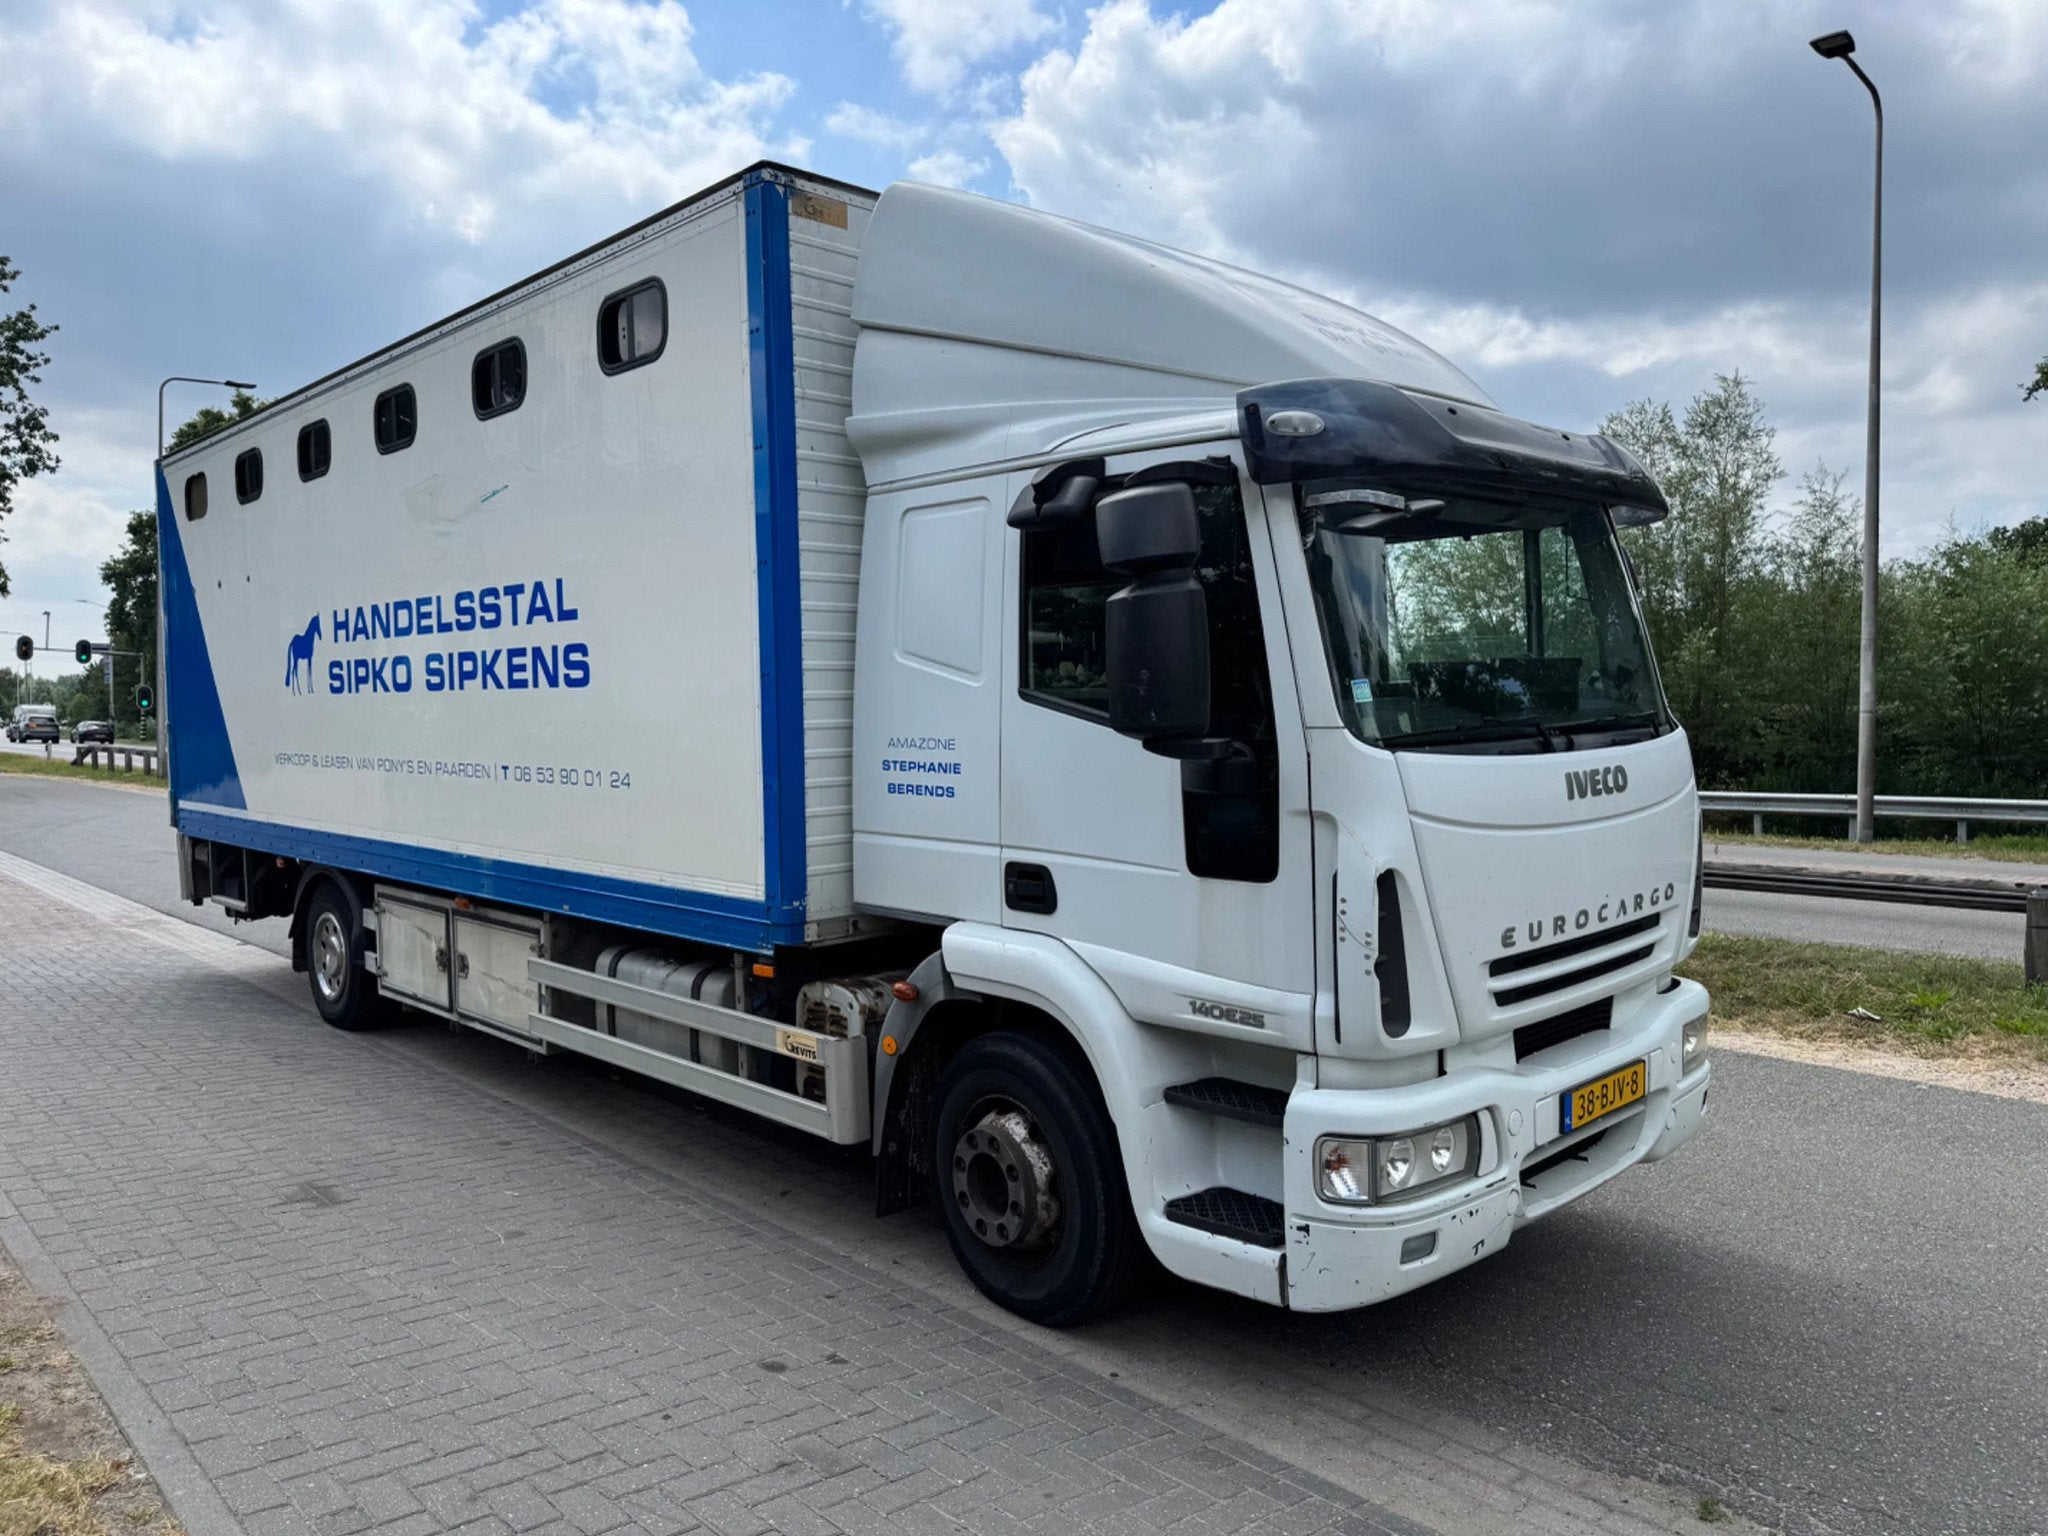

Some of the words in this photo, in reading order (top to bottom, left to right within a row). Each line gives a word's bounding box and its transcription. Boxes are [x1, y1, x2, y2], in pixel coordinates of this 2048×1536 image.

[332, 577, 579, 644] HANDELSSTAL
[328, 655, 413, 695] SIPKO
[424, 642, 591, 692] SIPKENS
[887, 737, 956, 751] AMAZONE
[273, 752, 311, 767] VERKOOP
[312, 754, 319, 768] &
[320, 754, 353, 770] LEASEN
[355, 757, 375, 772] VAN
[377, 758, 414, 774] PONY'S
[417, 760, 432, 775] EN
[436, 761, 491, 779] PAARDEN
[501, 765, 510, 780] T
[514, 765, 532, 782] 06
[536, 766, 555, 784] 53
[560, 768, 579, 786] 90
[583, 769, 602, 787] 01
[610, 771, 631, 789] 24
[881, 759, 962, 775] STEPHANIE
[1564, 764, 1629, 801] IVECO
[887, 782, 956, 798] BERENDS
[1500, 882, 1675, 949] EUROCARGO
[1188, 1000, 1265, 1029] 140E25
[1577, 1069, 1639, 1120] 38-BJV-8
